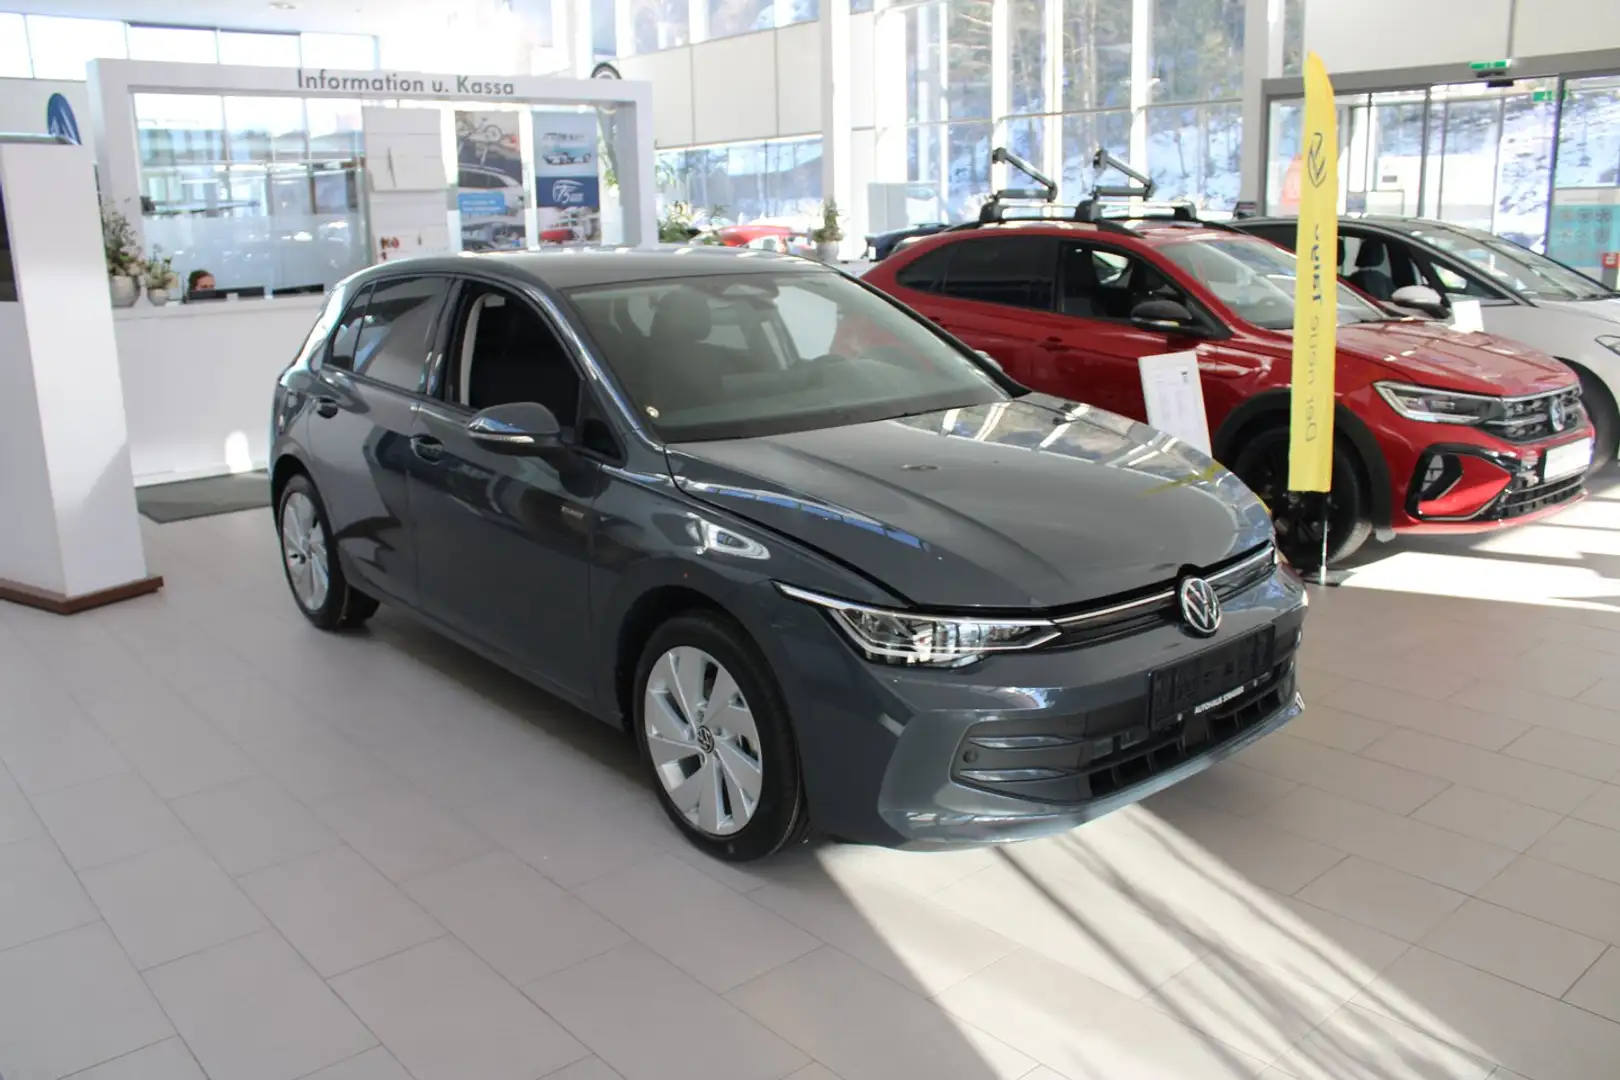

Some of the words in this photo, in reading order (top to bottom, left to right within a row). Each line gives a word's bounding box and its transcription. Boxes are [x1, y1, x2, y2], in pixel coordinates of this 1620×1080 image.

[297, 69, 424, 92] Information
[432, 79, 449, 93] u.
[456, 75, 515, 95] Kassa
